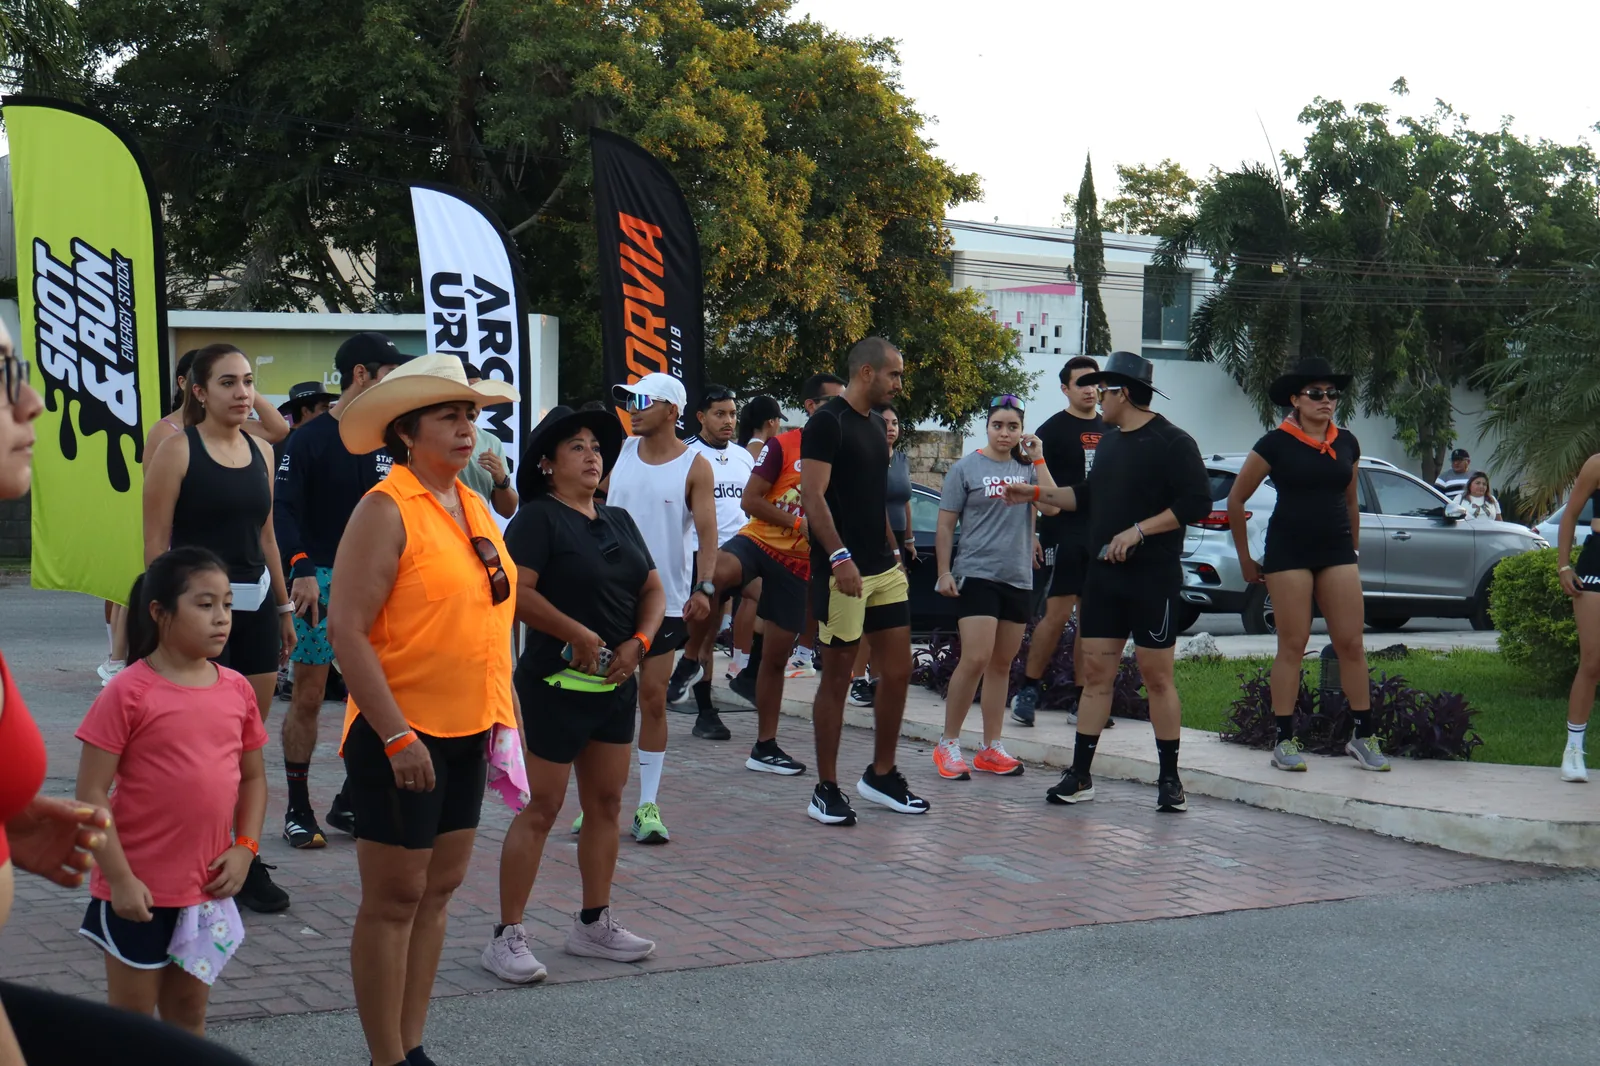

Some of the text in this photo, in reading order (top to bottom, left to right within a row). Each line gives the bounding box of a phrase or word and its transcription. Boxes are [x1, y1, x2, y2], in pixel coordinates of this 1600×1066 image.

[35, 240, 79, 393] SHOT
[115, 256, 135, 363] ENERGY STOCK
[619, 211, 669, 386] ORVIA
[74, 241, 138, 427] & RUN
[670, 325, 683, 379] CLUB
[714, 483, 743, 499] dida
[982, 475, 1026, 486] GO ONE
[984, 485, 1004, 497] MO
[1579, 575, 1600, 585] NIK
